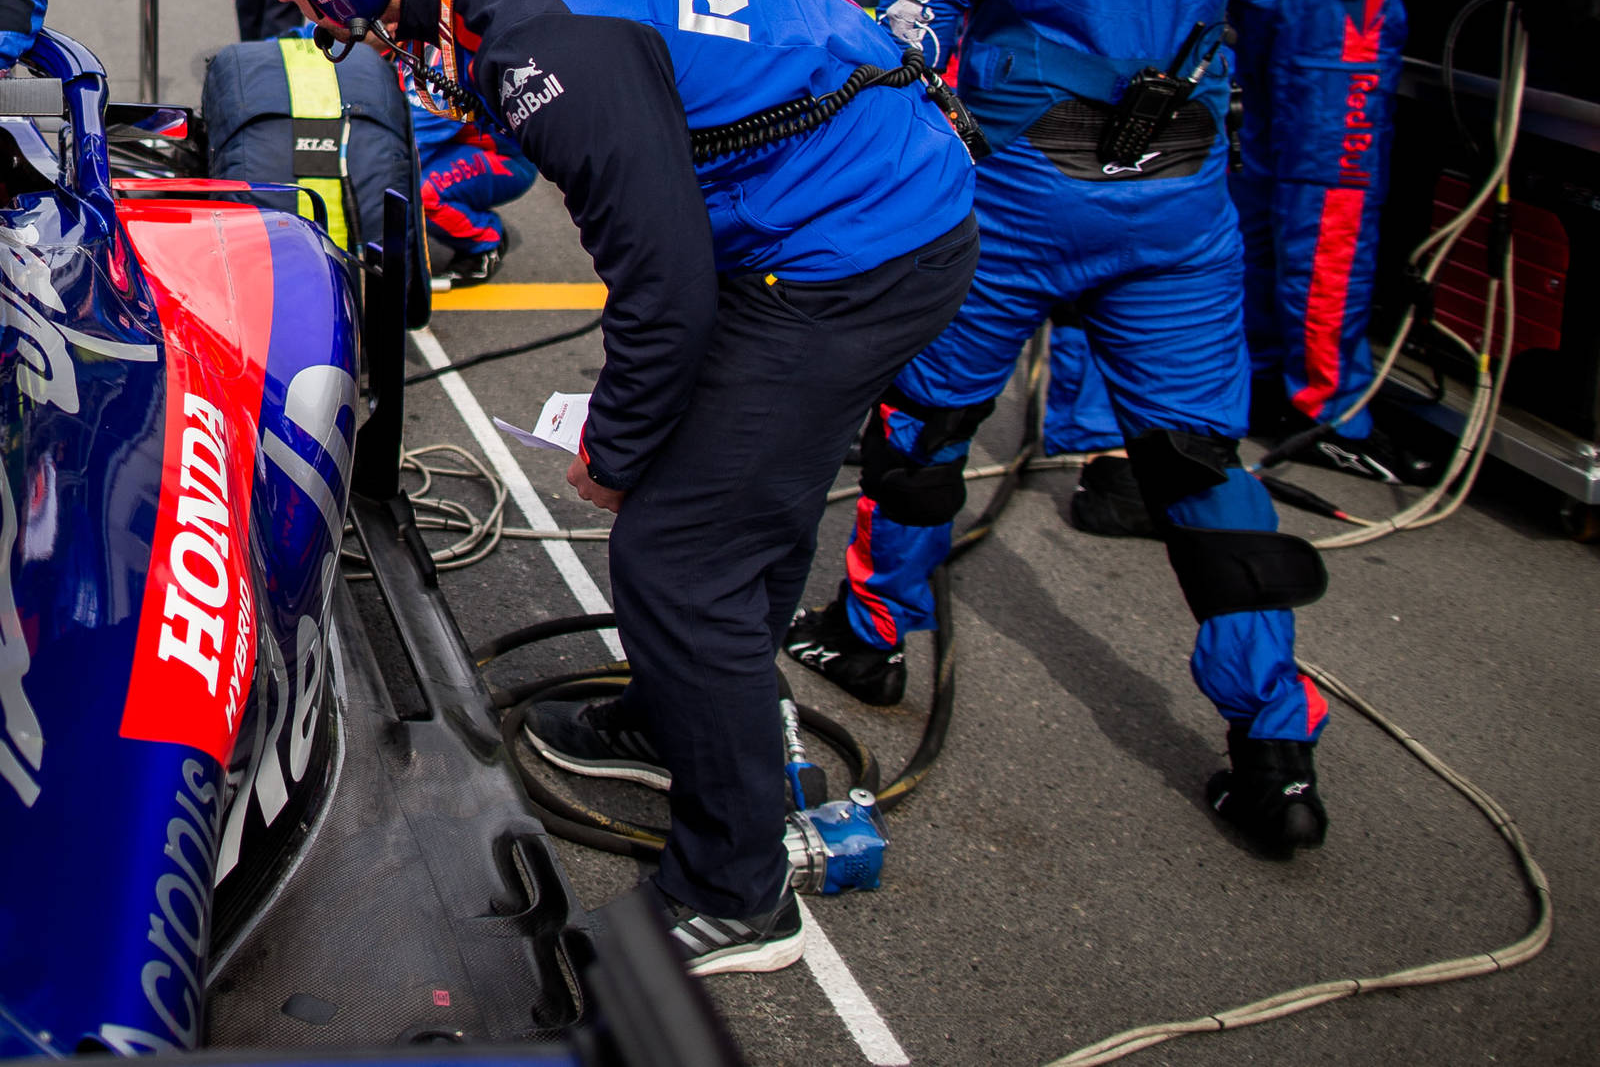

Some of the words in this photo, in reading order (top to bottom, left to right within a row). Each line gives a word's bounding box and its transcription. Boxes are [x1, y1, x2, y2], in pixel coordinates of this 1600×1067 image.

[506, 99, 528, 132] Red
[523, 73, 564, 114] Bull
[157, 392, 228, 698] HONDA
[224, 575, 253, 733] HYBRID
[99, 758, 220, 1059] Acronis
